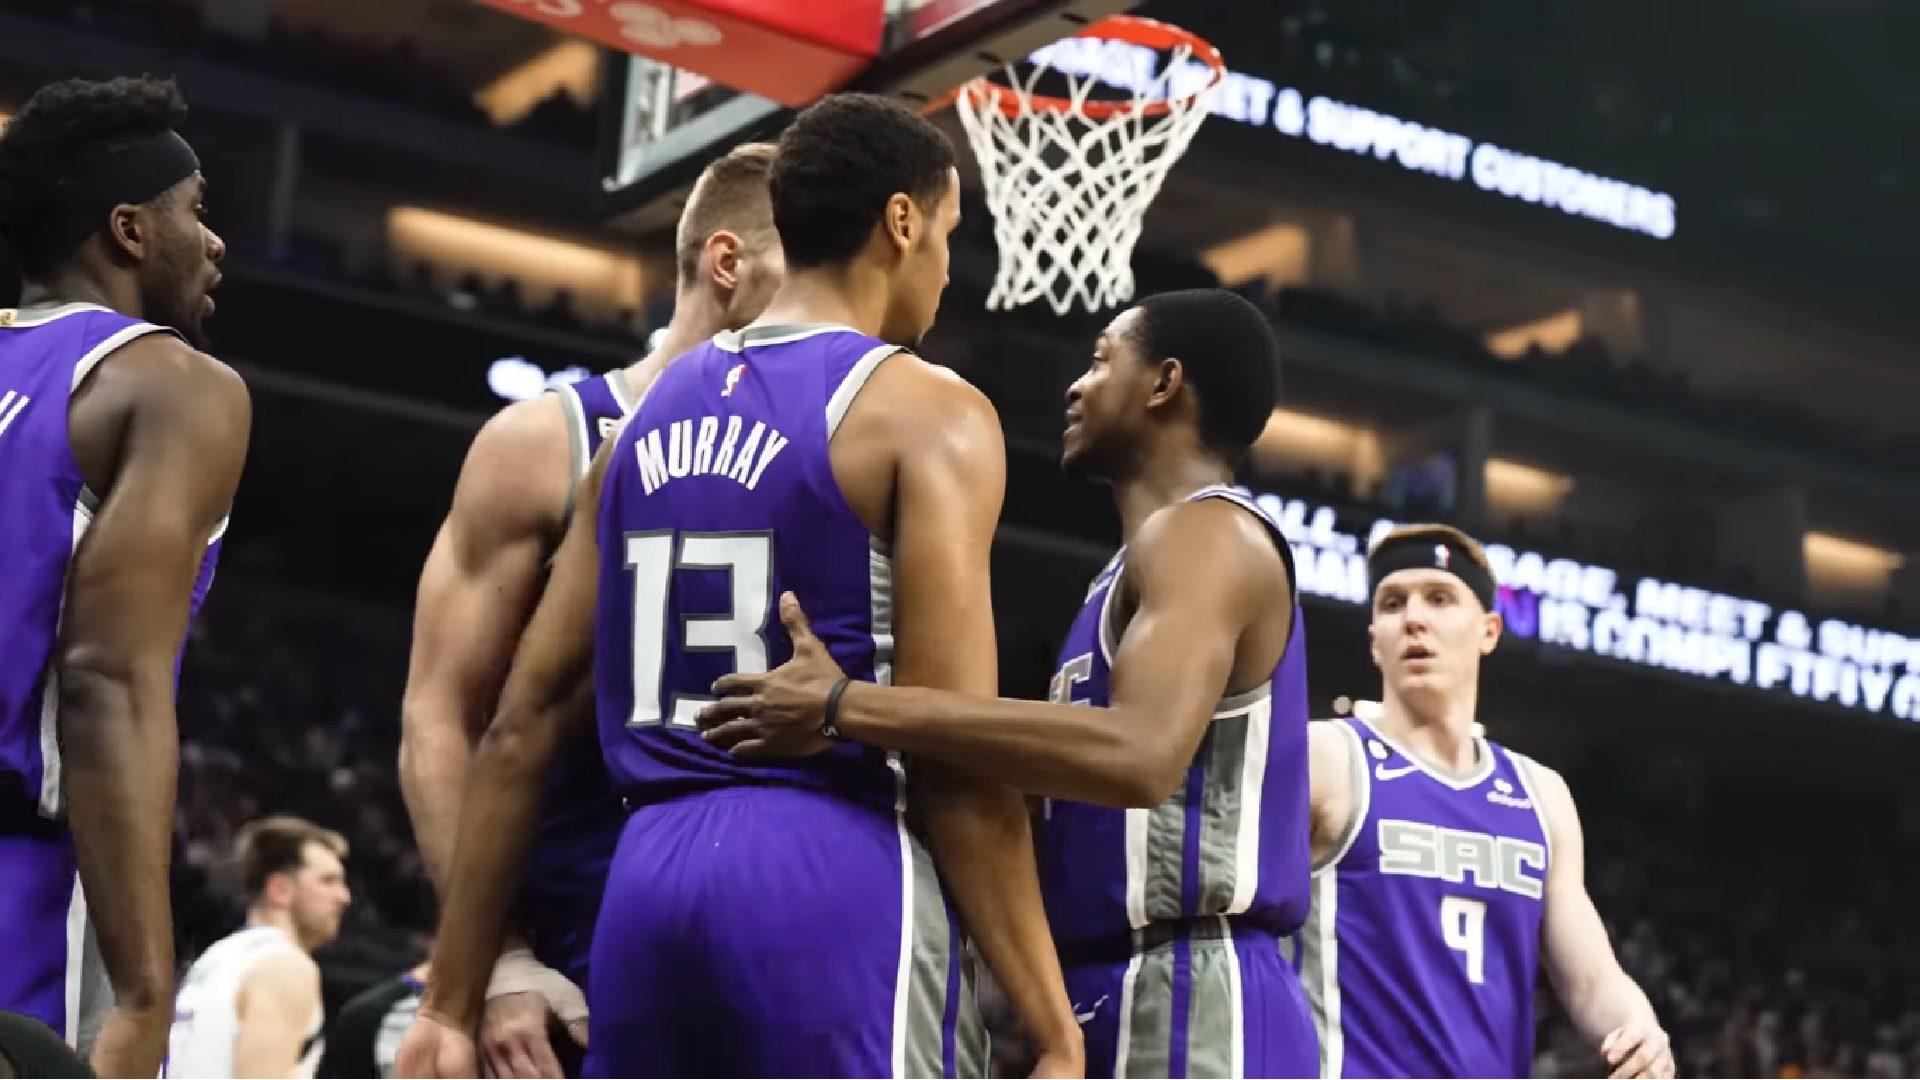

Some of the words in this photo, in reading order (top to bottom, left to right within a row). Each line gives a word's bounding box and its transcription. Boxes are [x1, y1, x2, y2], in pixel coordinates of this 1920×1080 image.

[1307, 95, 1472, 180] SUPPORT
[1472, 142, 1675, 239] CUSTOMERS
[634, 415, 789, 496] MURRAY
[623, 527, 774, 729] 13
[1377, 819, 1546, 900] SAC
[1439, 894, 1488, 985] 9
